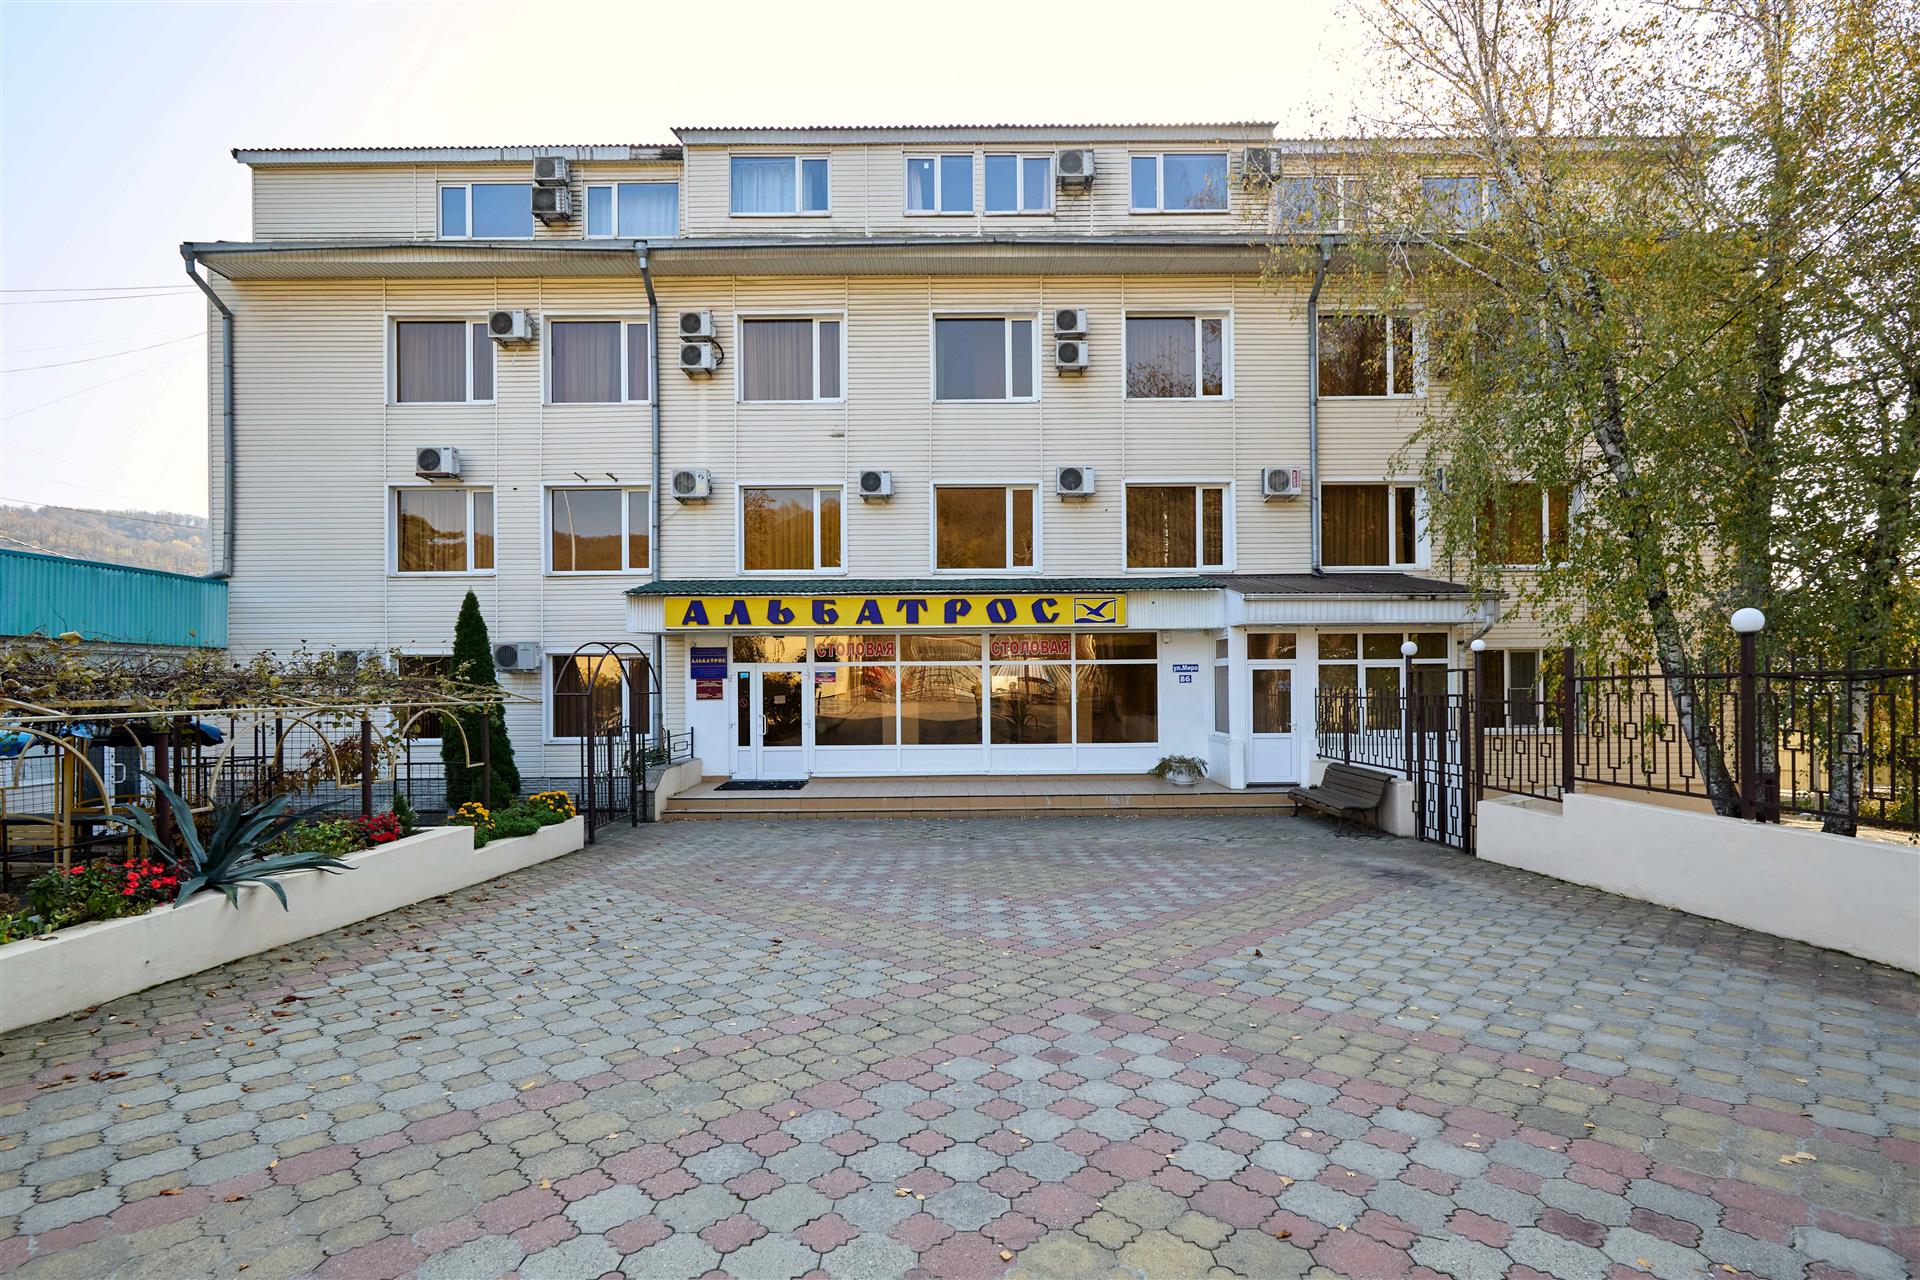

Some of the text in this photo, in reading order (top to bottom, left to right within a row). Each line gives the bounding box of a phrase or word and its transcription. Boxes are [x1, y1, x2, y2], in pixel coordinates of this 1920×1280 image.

[682, 598, 1060, 625] АЛЬБАТРОС
[817, 641, 895, 658] СТОЛОВАЯ
[991, 639, 1071, 656] СТОЛОВАЯ
